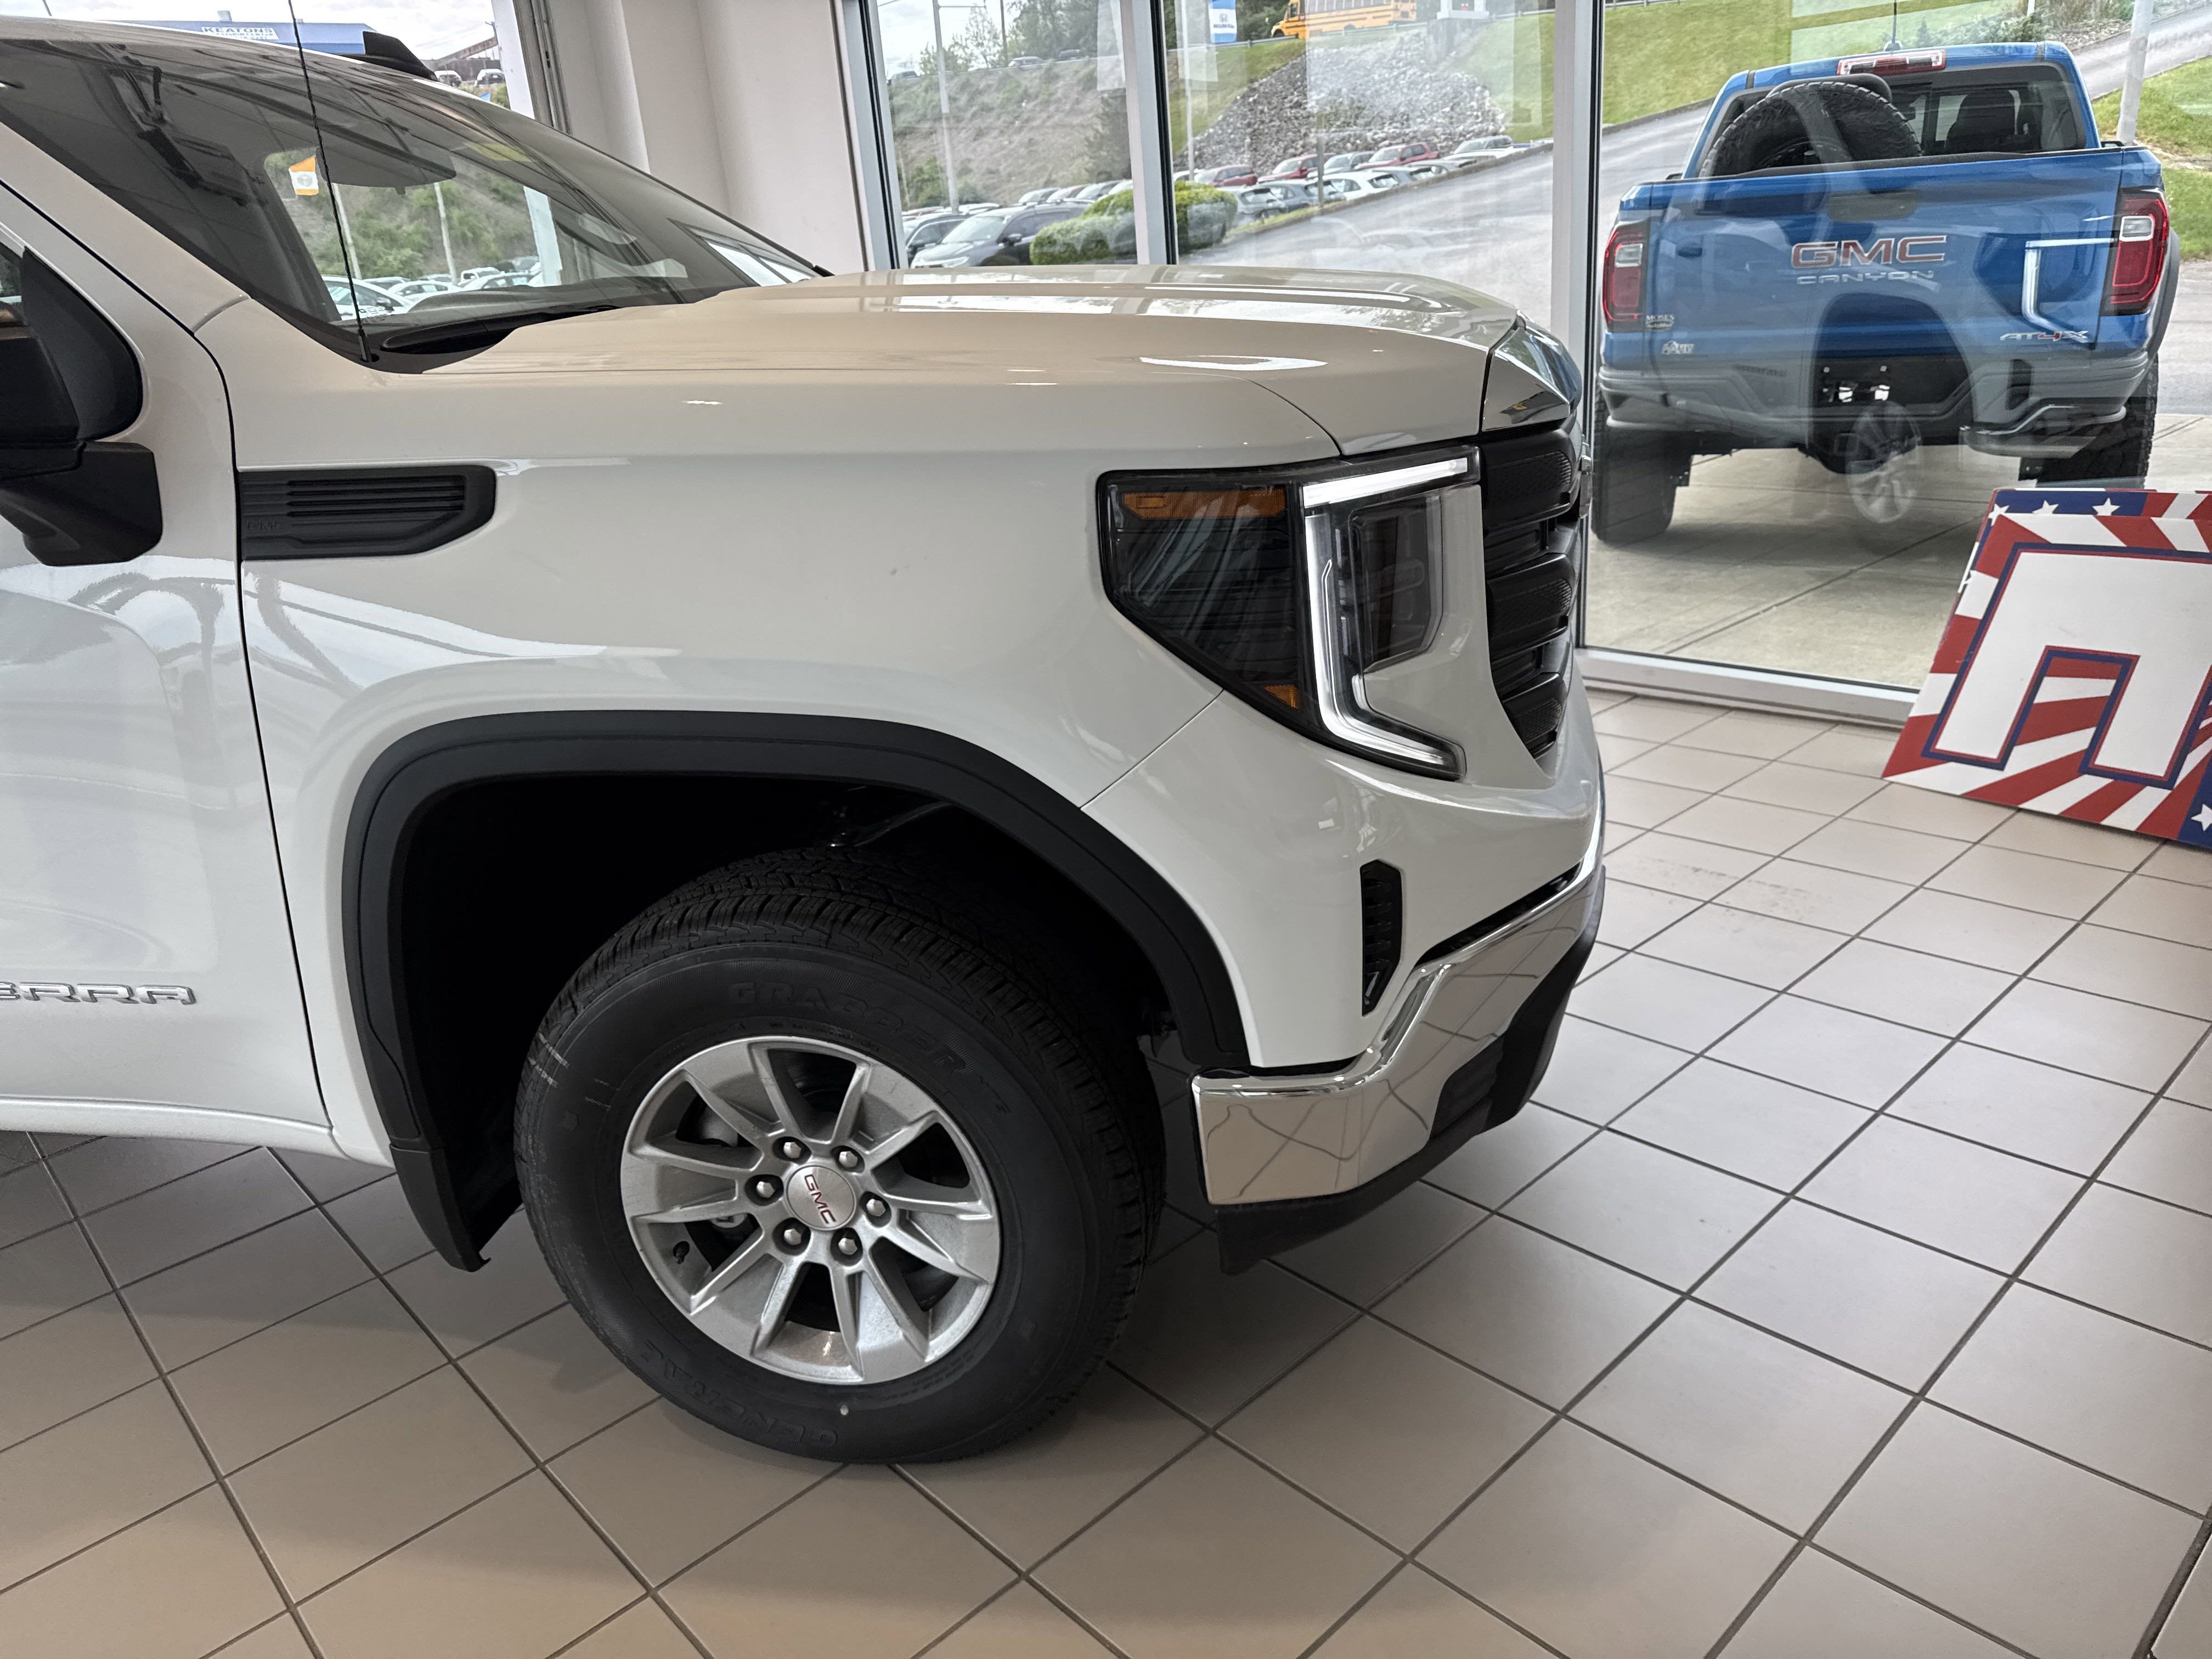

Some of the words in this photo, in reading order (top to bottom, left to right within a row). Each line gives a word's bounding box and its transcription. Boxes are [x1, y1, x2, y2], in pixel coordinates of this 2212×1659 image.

[1791, 235, 1947, 268] GMC
[1796, 270, 1934, 285] CANYON
[2000, 330, 2089, 342] AT4X
[727, 981, 967, 1074] GRABBER
[804, 1173, 837, 1224] GMC
[636, 1338, 839, 1449] GENERAL
